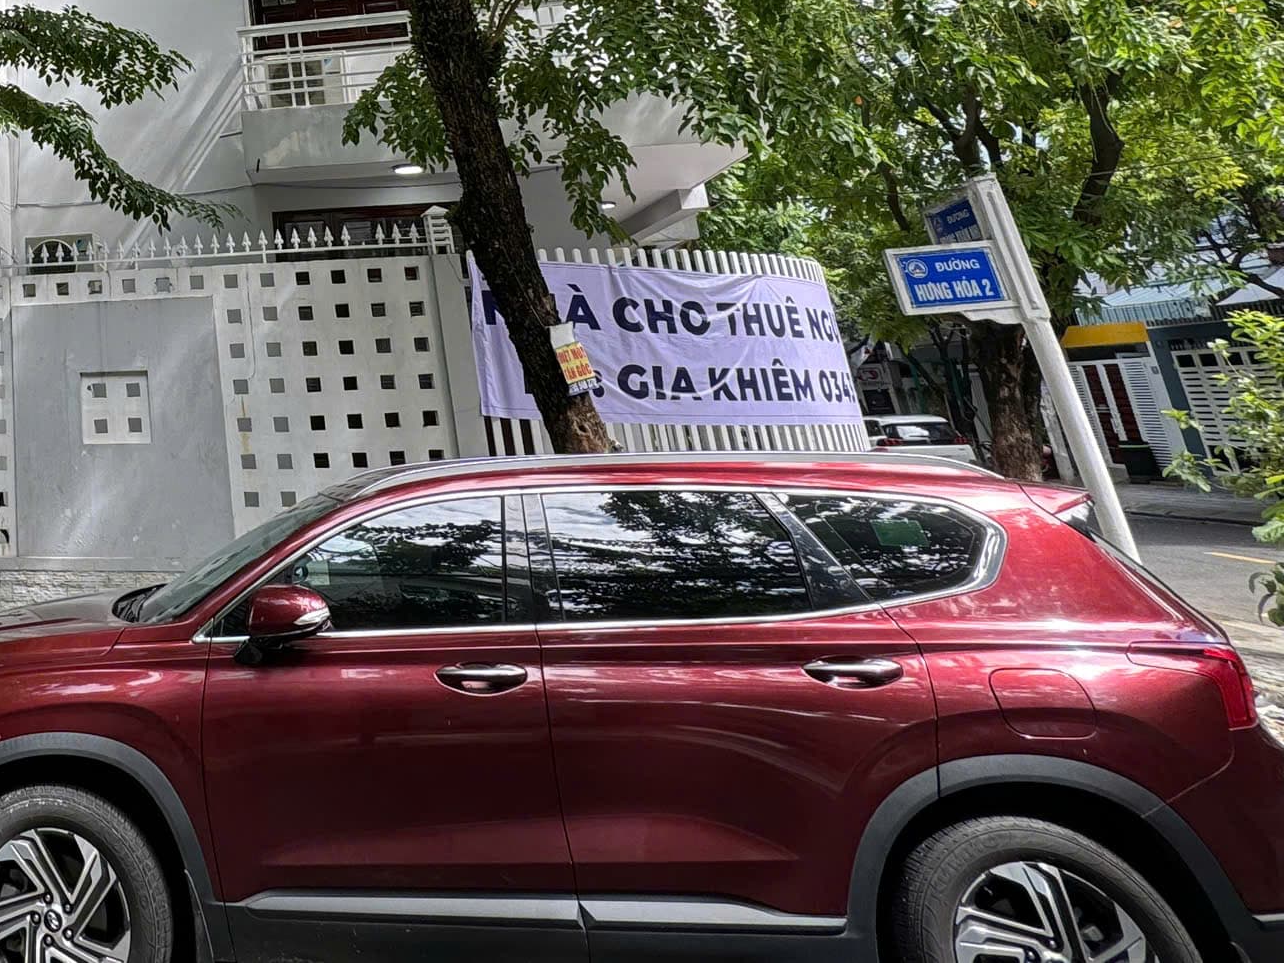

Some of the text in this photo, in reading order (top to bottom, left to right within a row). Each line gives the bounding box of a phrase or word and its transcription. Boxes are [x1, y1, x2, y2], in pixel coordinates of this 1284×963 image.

[934, 257, 980, 273] ĐƯỜNG
[914, 280, 953, 302] HƯNG
[981, 278, 995, 297] 2
[612, 296, 711, 336] CHO
[716, 295, 805, 338] THUÊ
[617, 363, 703, 401] GIA
[707, 357, 816, 402] KHIÊM
